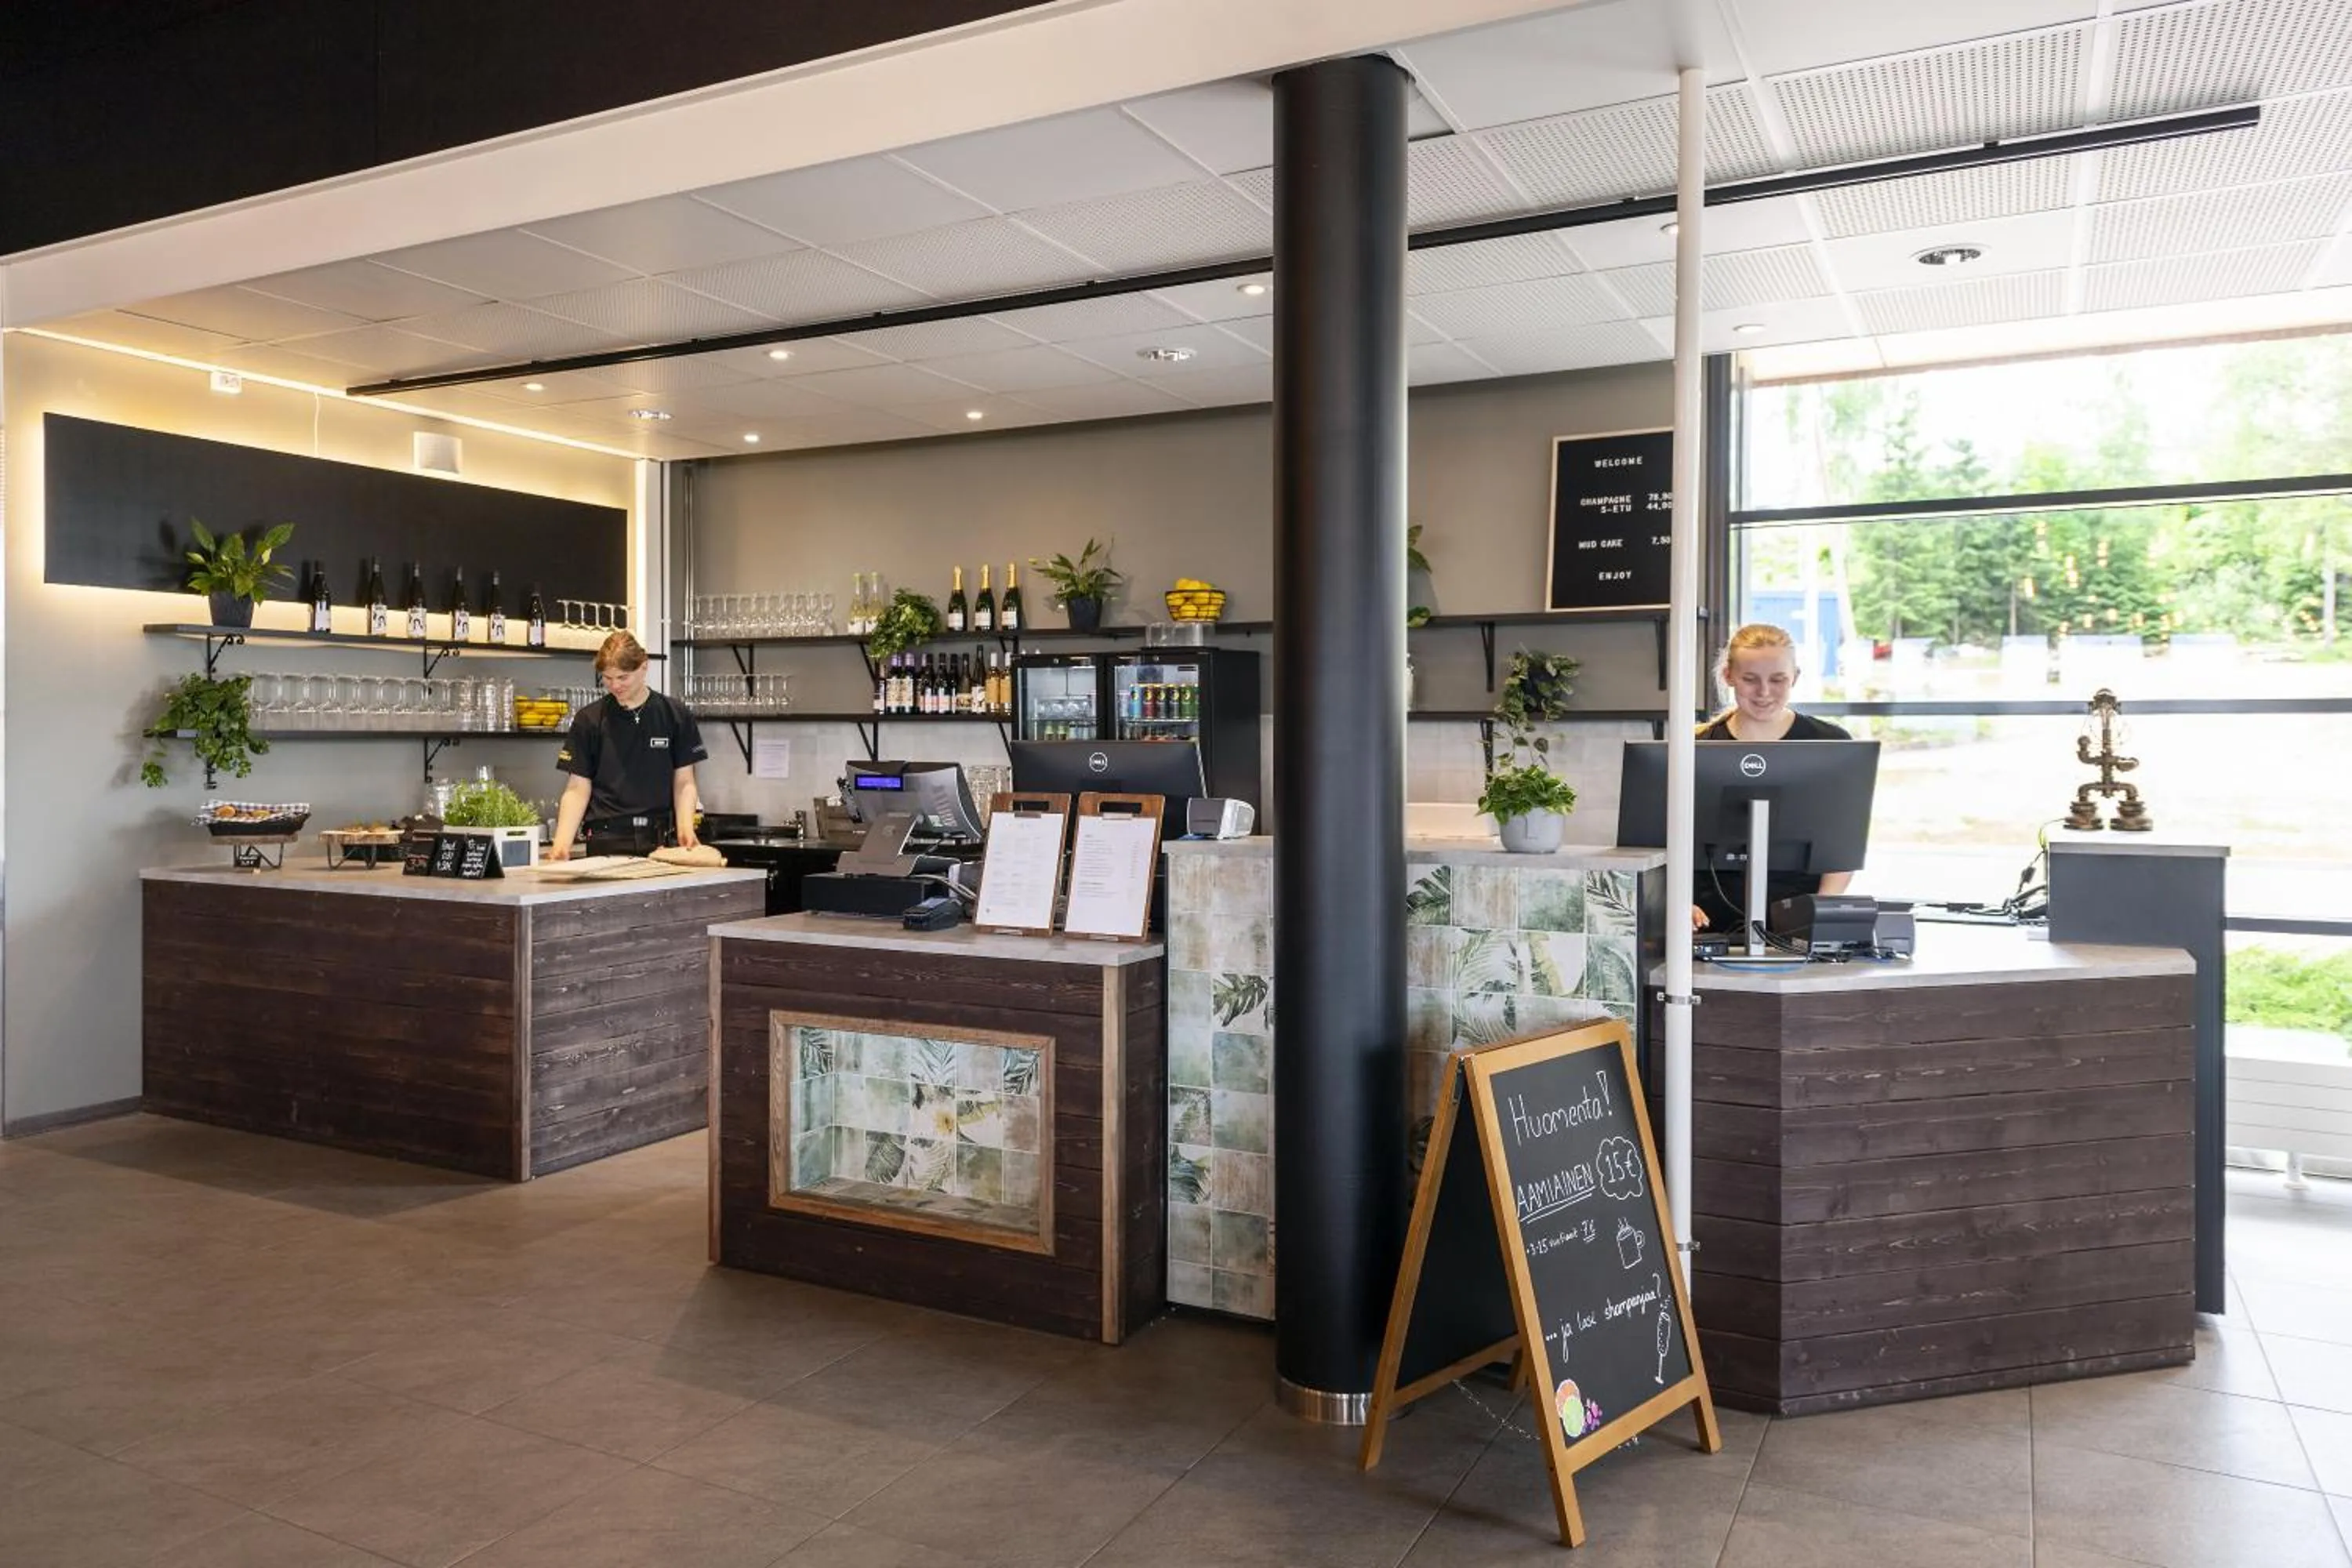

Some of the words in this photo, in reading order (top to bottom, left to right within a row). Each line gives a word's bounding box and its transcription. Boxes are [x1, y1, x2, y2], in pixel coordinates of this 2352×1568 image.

[1594, 456, 1642, 468] WELCOME
[1580, 495, 1632, 506] CHAMPAGNE
[1600, 504, 1632, 514] S-ETU
[1601, 539, 1623, 548] CAKE
[1599, 571, 1632, 581] ENJOY
[1508, 1070, 1613, 1147] Huomenta!
[1606, 1149, 1637, 1183] 15€
[1517, 1163, 1595, 1218] AAMIAINEN
